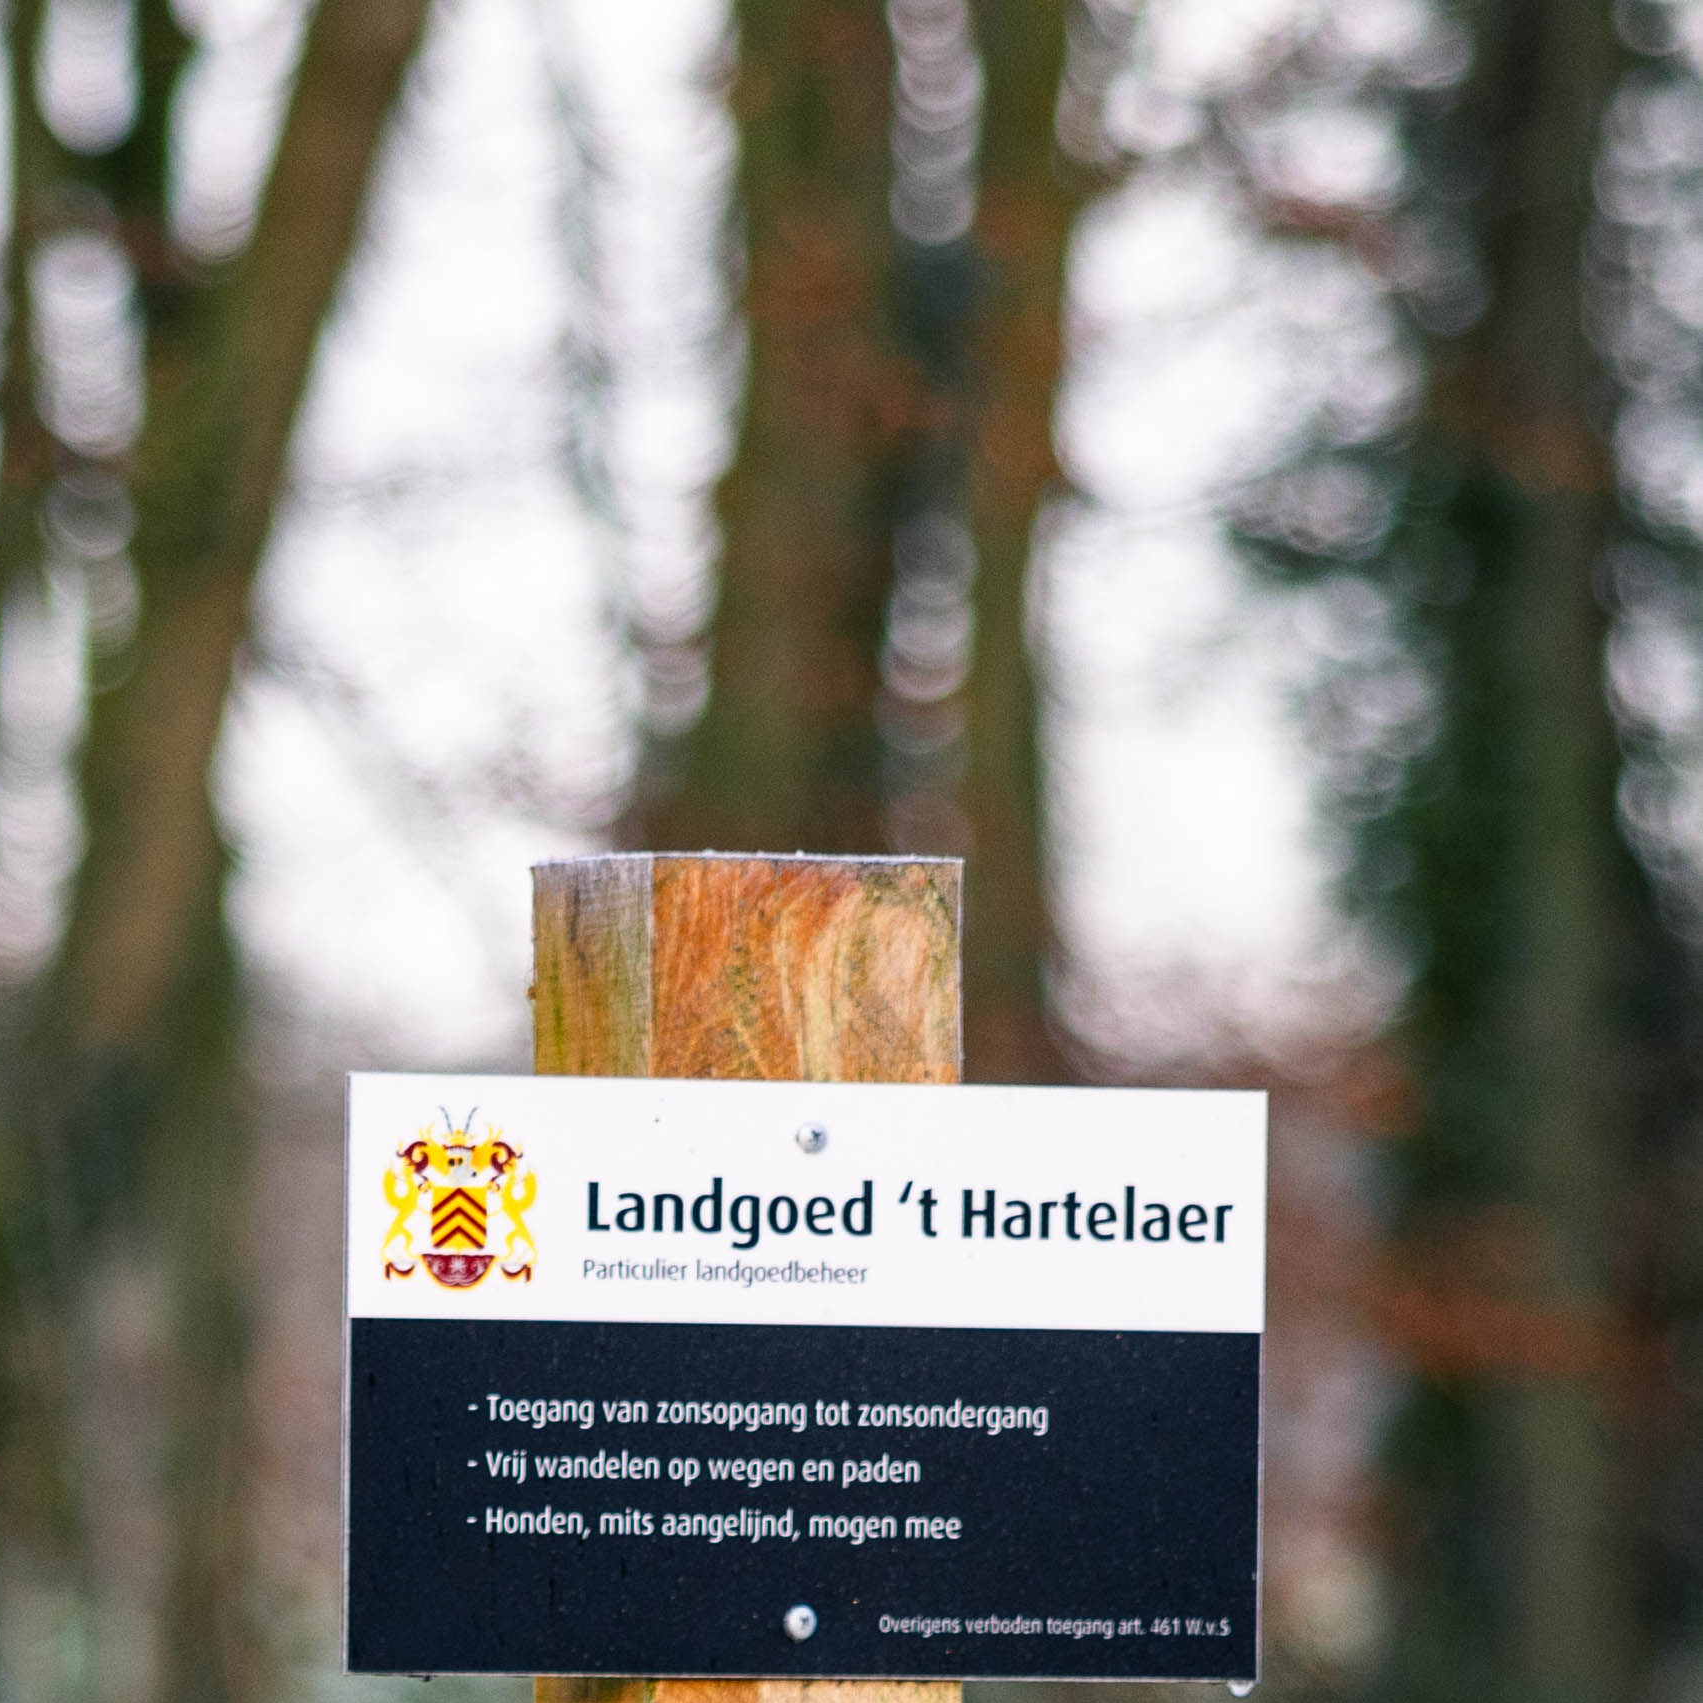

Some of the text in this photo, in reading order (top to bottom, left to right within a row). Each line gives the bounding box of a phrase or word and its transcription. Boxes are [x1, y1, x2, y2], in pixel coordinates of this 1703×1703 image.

[587, 1176, 873, 1251] Landgoed
[962, 1185, 1234, 1244] Hartelaer
[582, 1257, 869, 1287] Particulier landgoedbeheer
[486, 1393, 595, 1430] Toegang
[602, 1400, 649, 1423] van
[656, 1400, 808, 1433] zonsopgang
[814, 1399, 851, 1427] tot
[857, 1398, 1049, 1437] zonsondergang
[485, 1449, 527, 1484] Vrij
[534, 1449, 661, 1480] wandelen
[668, 1457, 701, 1487] op
[707, 1457, 795, 1488] wegen
[801, 1458, 835, 1482] en
[842, 1453, 921, 1489] paden
[485, 1505, 591, 1541] Honden,
[599, 1507, 655, 1536] mits
[661, 1507, 801, 1544] aangelijnd,
[808, 1515, 898, 1546] mogen
[905, 1516, 962, 1540] mee
[878, 1614, 962, 1638] Overigens
[965, 1615, 1042, 1635] verboden
[1046, 1617, 1114, 1640] toegang
[1117, 1618, 1144, 1636] art.
[1150, 1617, 1180, 1636] 461
